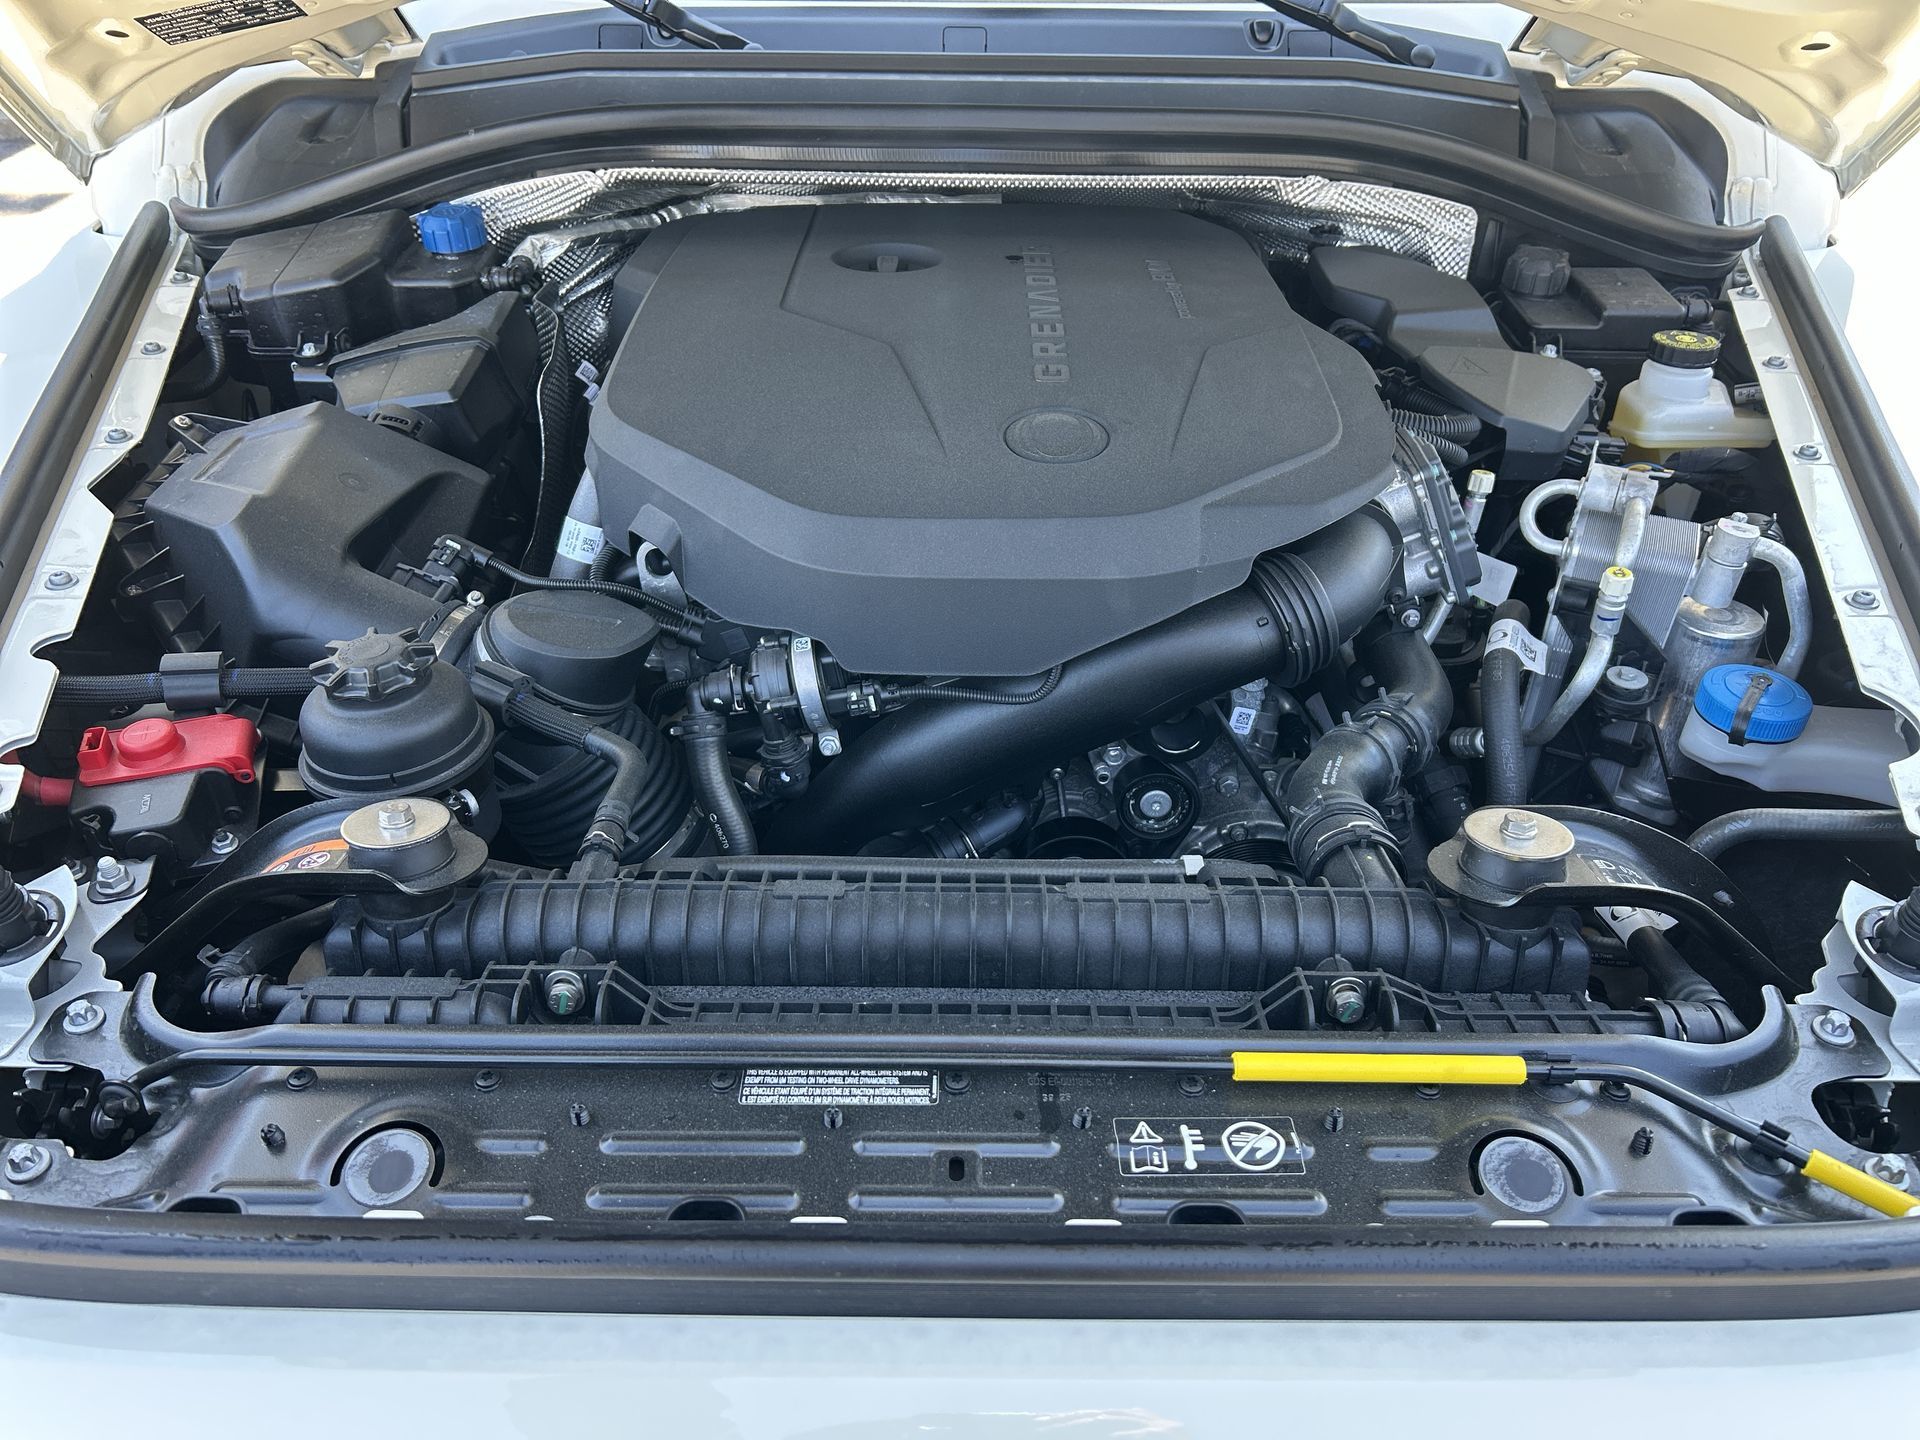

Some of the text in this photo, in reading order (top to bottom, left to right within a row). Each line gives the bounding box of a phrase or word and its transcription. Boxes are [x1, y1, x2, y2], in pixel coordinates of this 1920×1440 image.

[715, 824, 729, 849] 406270
[744, 1076, 764, 1084] EXEMPT
[764, 1076, 778, 1084] FROM
[787, 1076, 807, 1084] TESTING
[808, 1076, 816, 1084] ON
[845, 1076, 859, 1084] DRIVE
[742, 1087, 750, 1095] CE
[843, 1087, 850, 1095] DE
[851, 1087, 874, 1095] TRACTION
